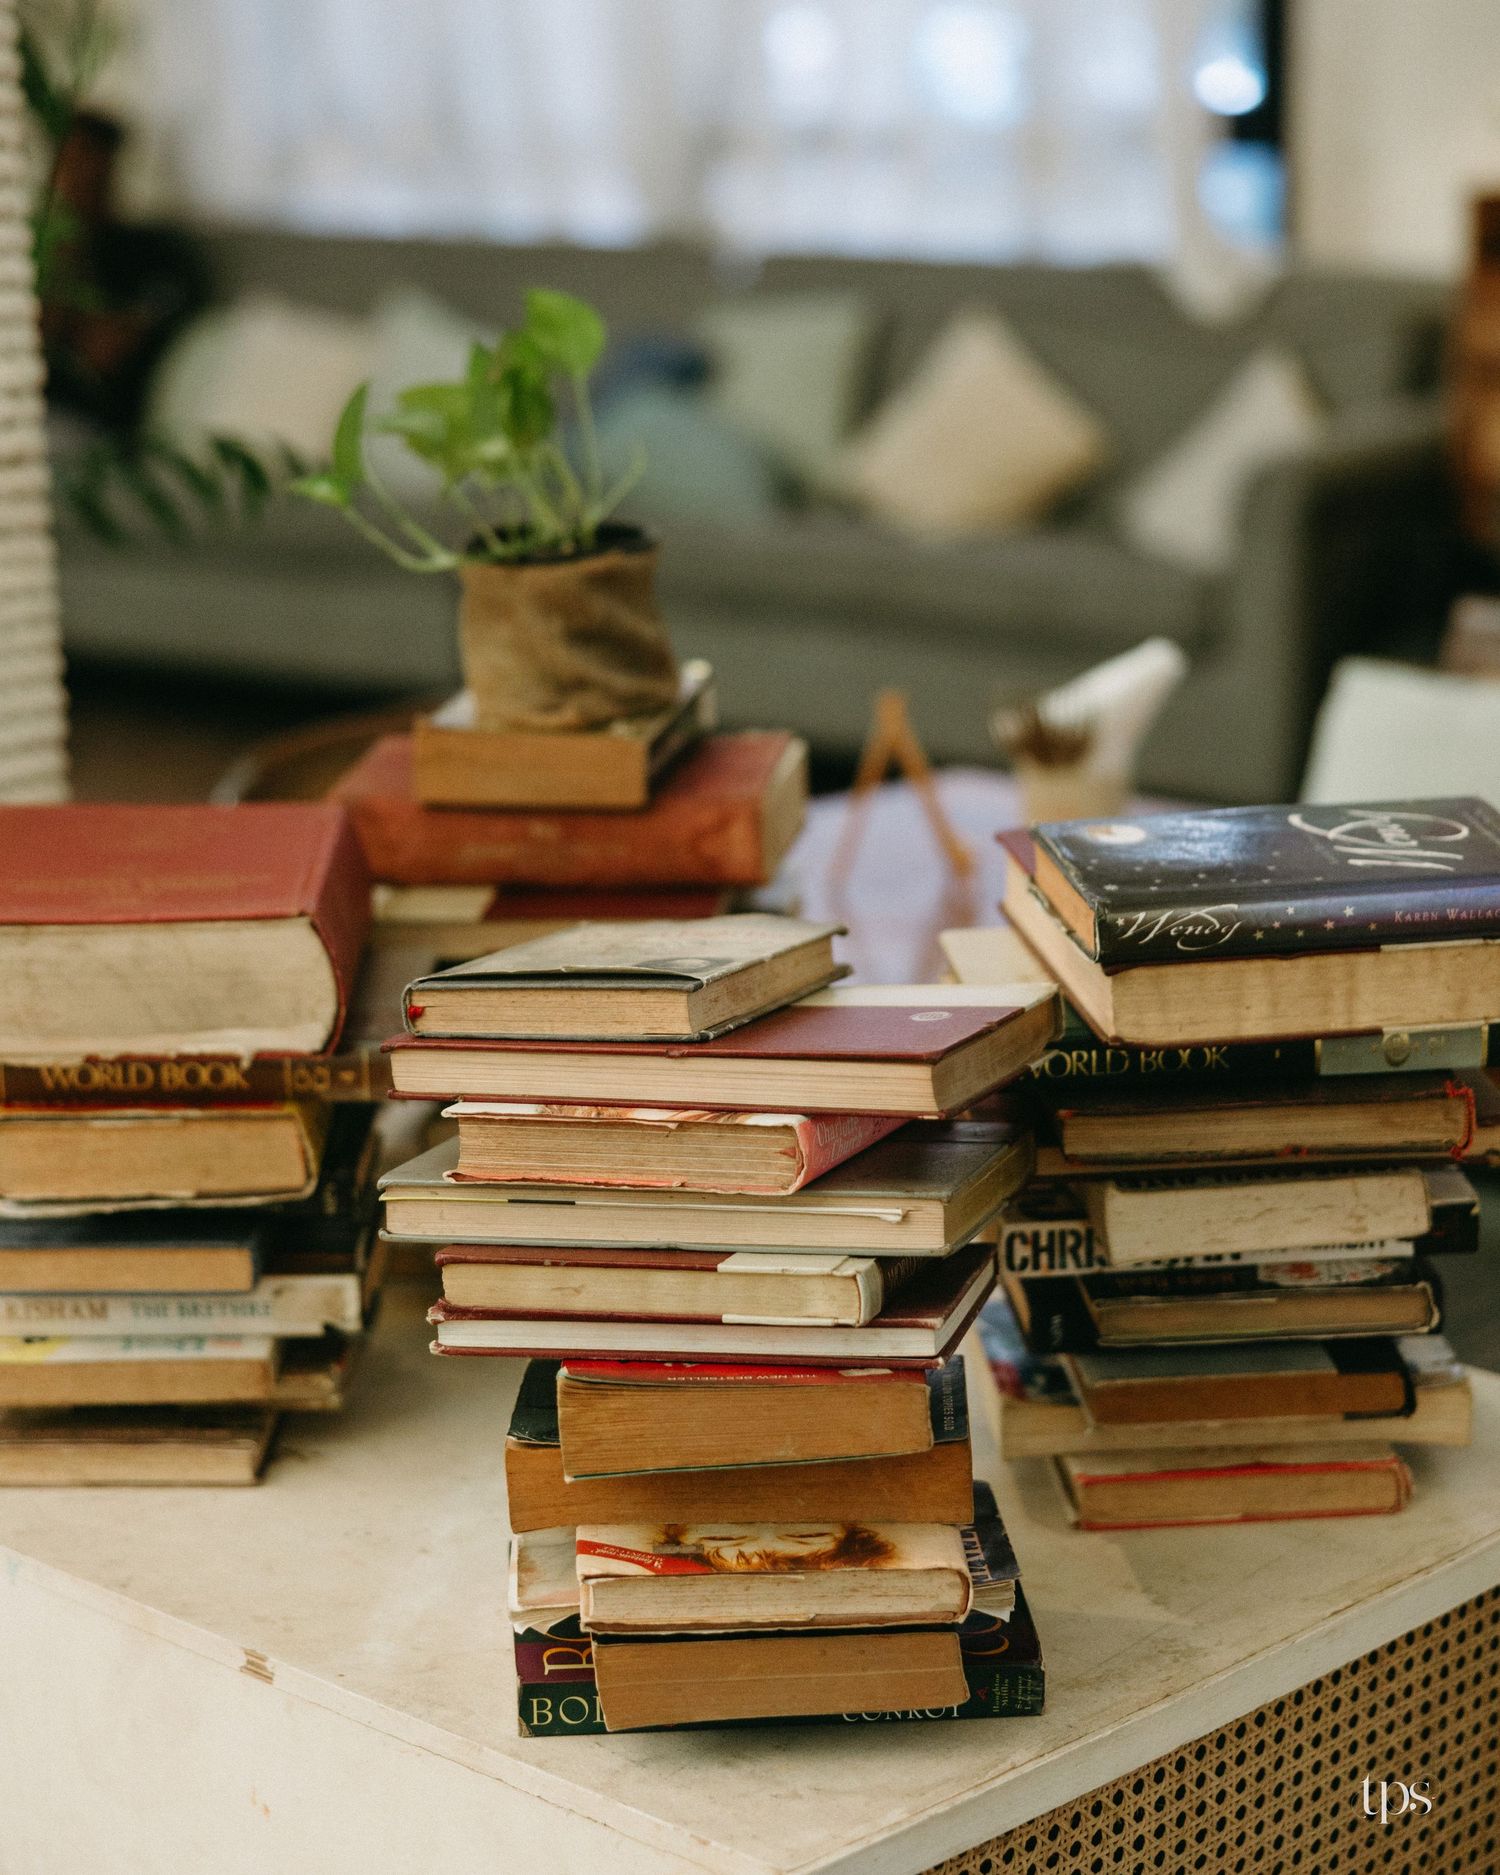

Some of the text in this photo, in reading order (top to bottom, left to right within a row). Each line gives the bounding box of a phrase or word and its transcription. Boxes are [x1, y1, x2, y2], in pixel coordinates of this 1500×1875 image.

[1119, 903, 1242, 950] Wendy
[1394, 910, 1438, 922] KAREN
[41, 1062, 250, 1092] WORLD BOOK
[943, 1416, 955, 1431] SOLD
